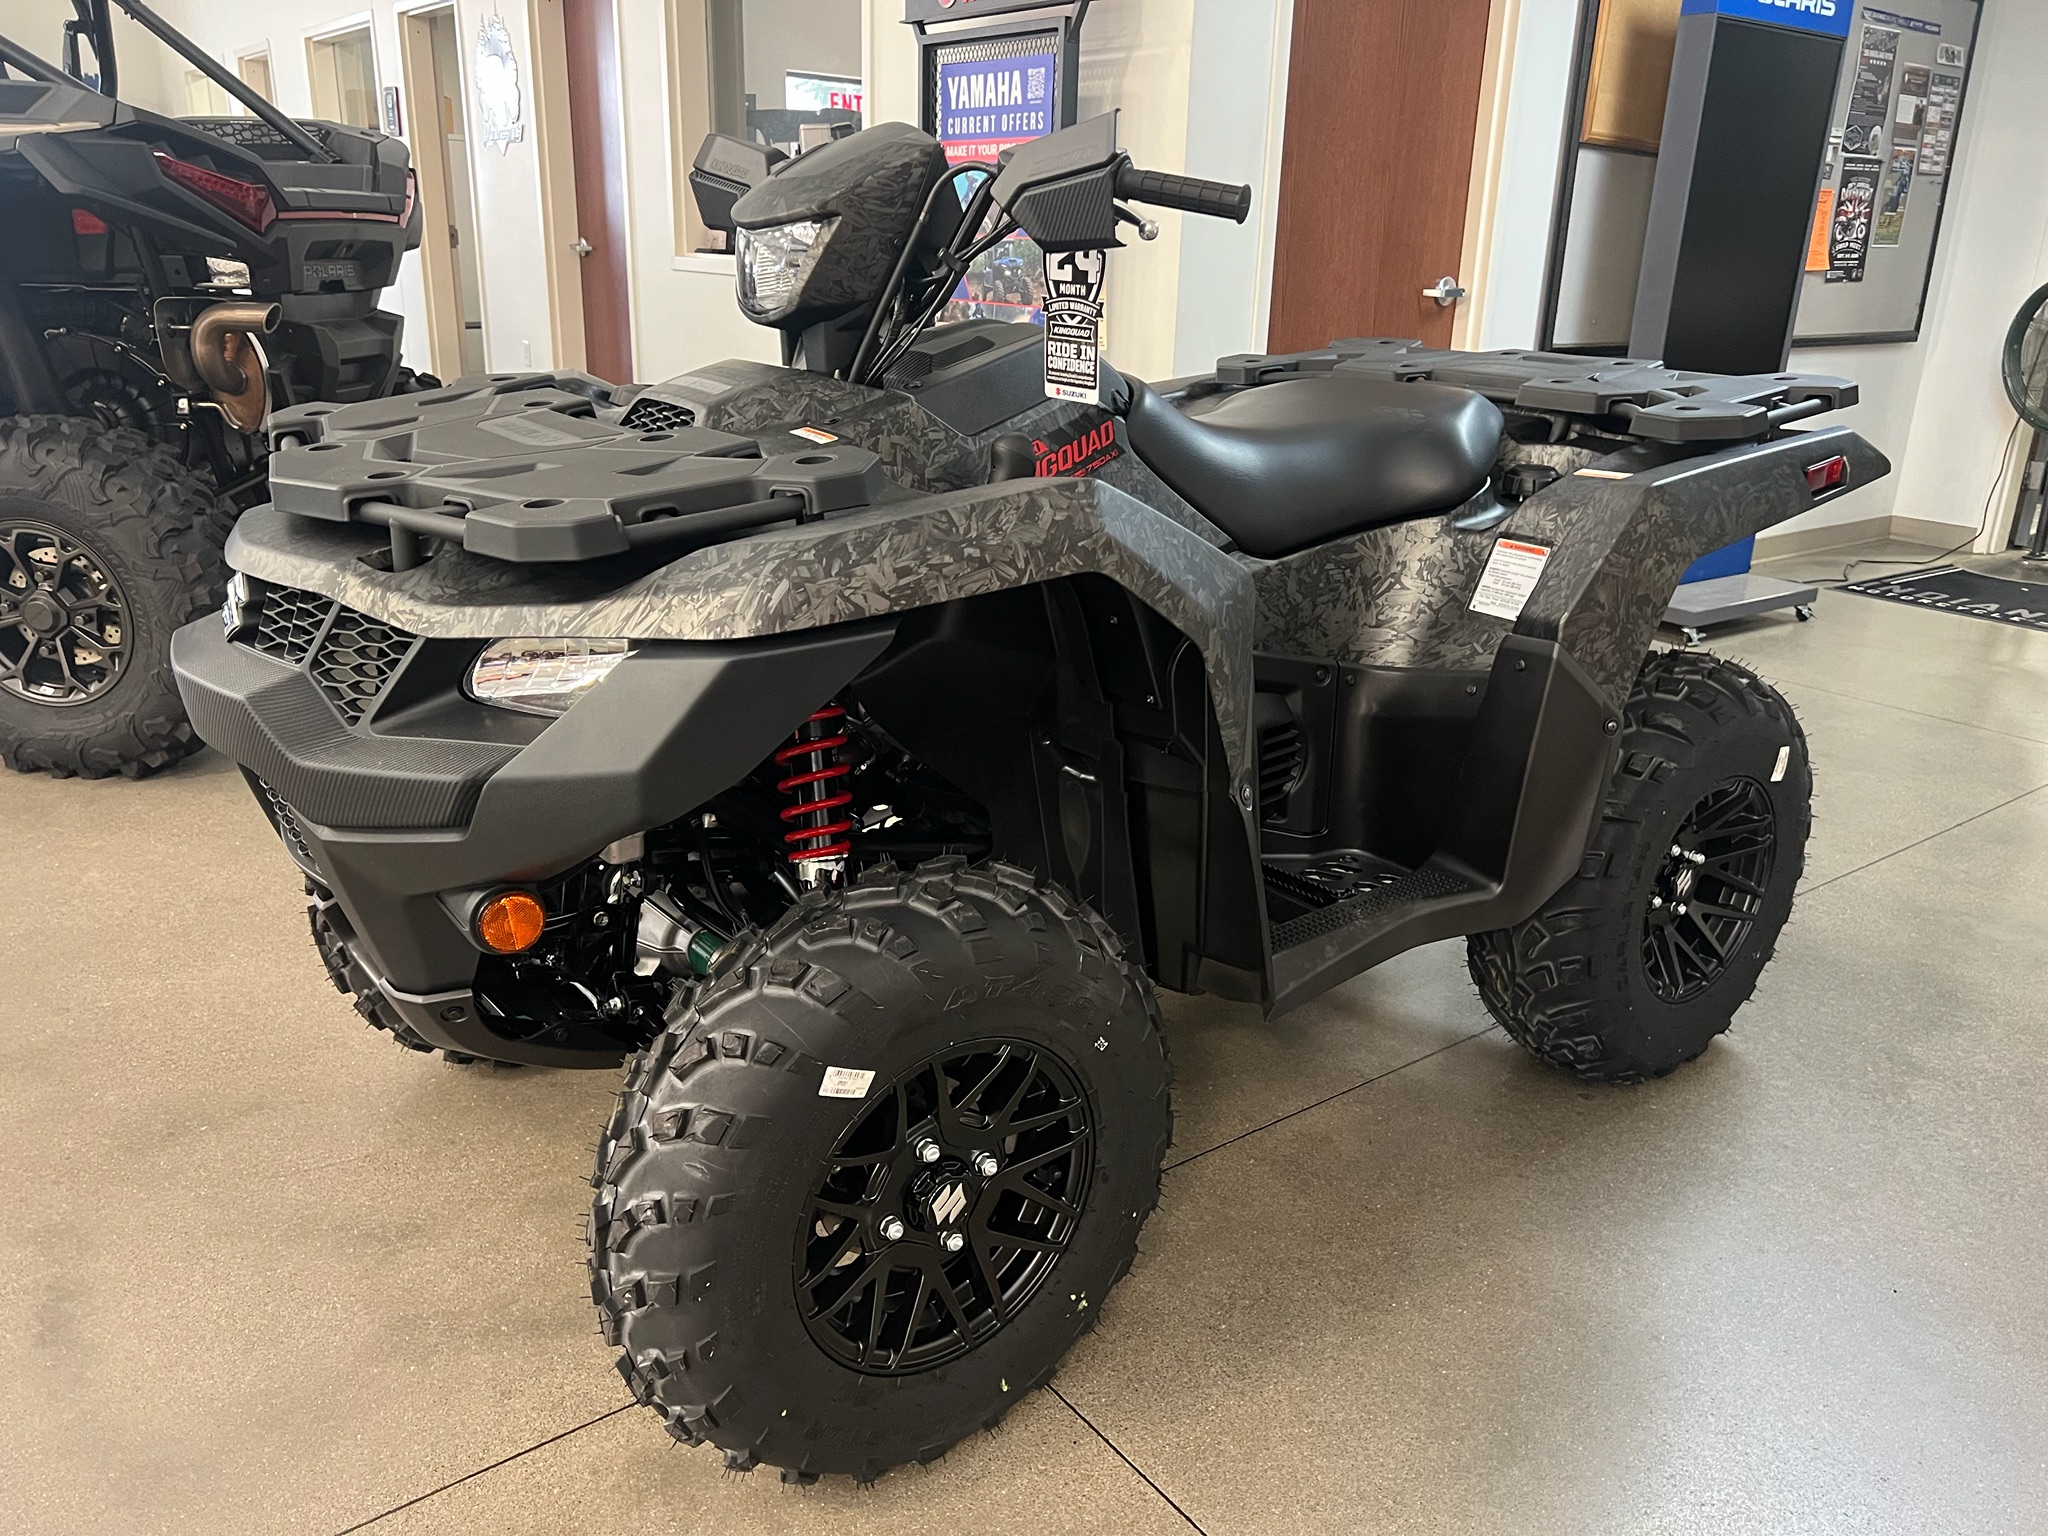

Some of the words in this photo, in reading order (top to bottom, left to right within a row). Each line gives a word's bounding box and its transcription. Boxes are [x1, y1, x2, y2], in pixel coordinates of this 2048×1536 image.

[1756, 0, 1837, 17] ARIS
[947, 69, 1022, 110] YAMAHA
[947, 114, 996, 135] CURRENT
[1001, 111, 1044, 132] OFFERS
[946, 144, 968, 157] MAKE
[968, 144, 976, 156] IT
[977, 143, 998, 156] YOUR
[303, 264, 355, 278] POLARIS
[1059, 282, 1086, 296] MONTH
[1048, 301, 1069, 312] LIMITED
[1069, 301, 1097, 317] WARRANTY
[1053, 324, 1091, 338] KINGQUAD
[1047, 340, 1078, 359] RIDE
[1080, 344, 1096, 361] IN
[1047, 356, 1096, 375] CONFIDENCE
[1062, 388, 1087, 399] SUZUKI
